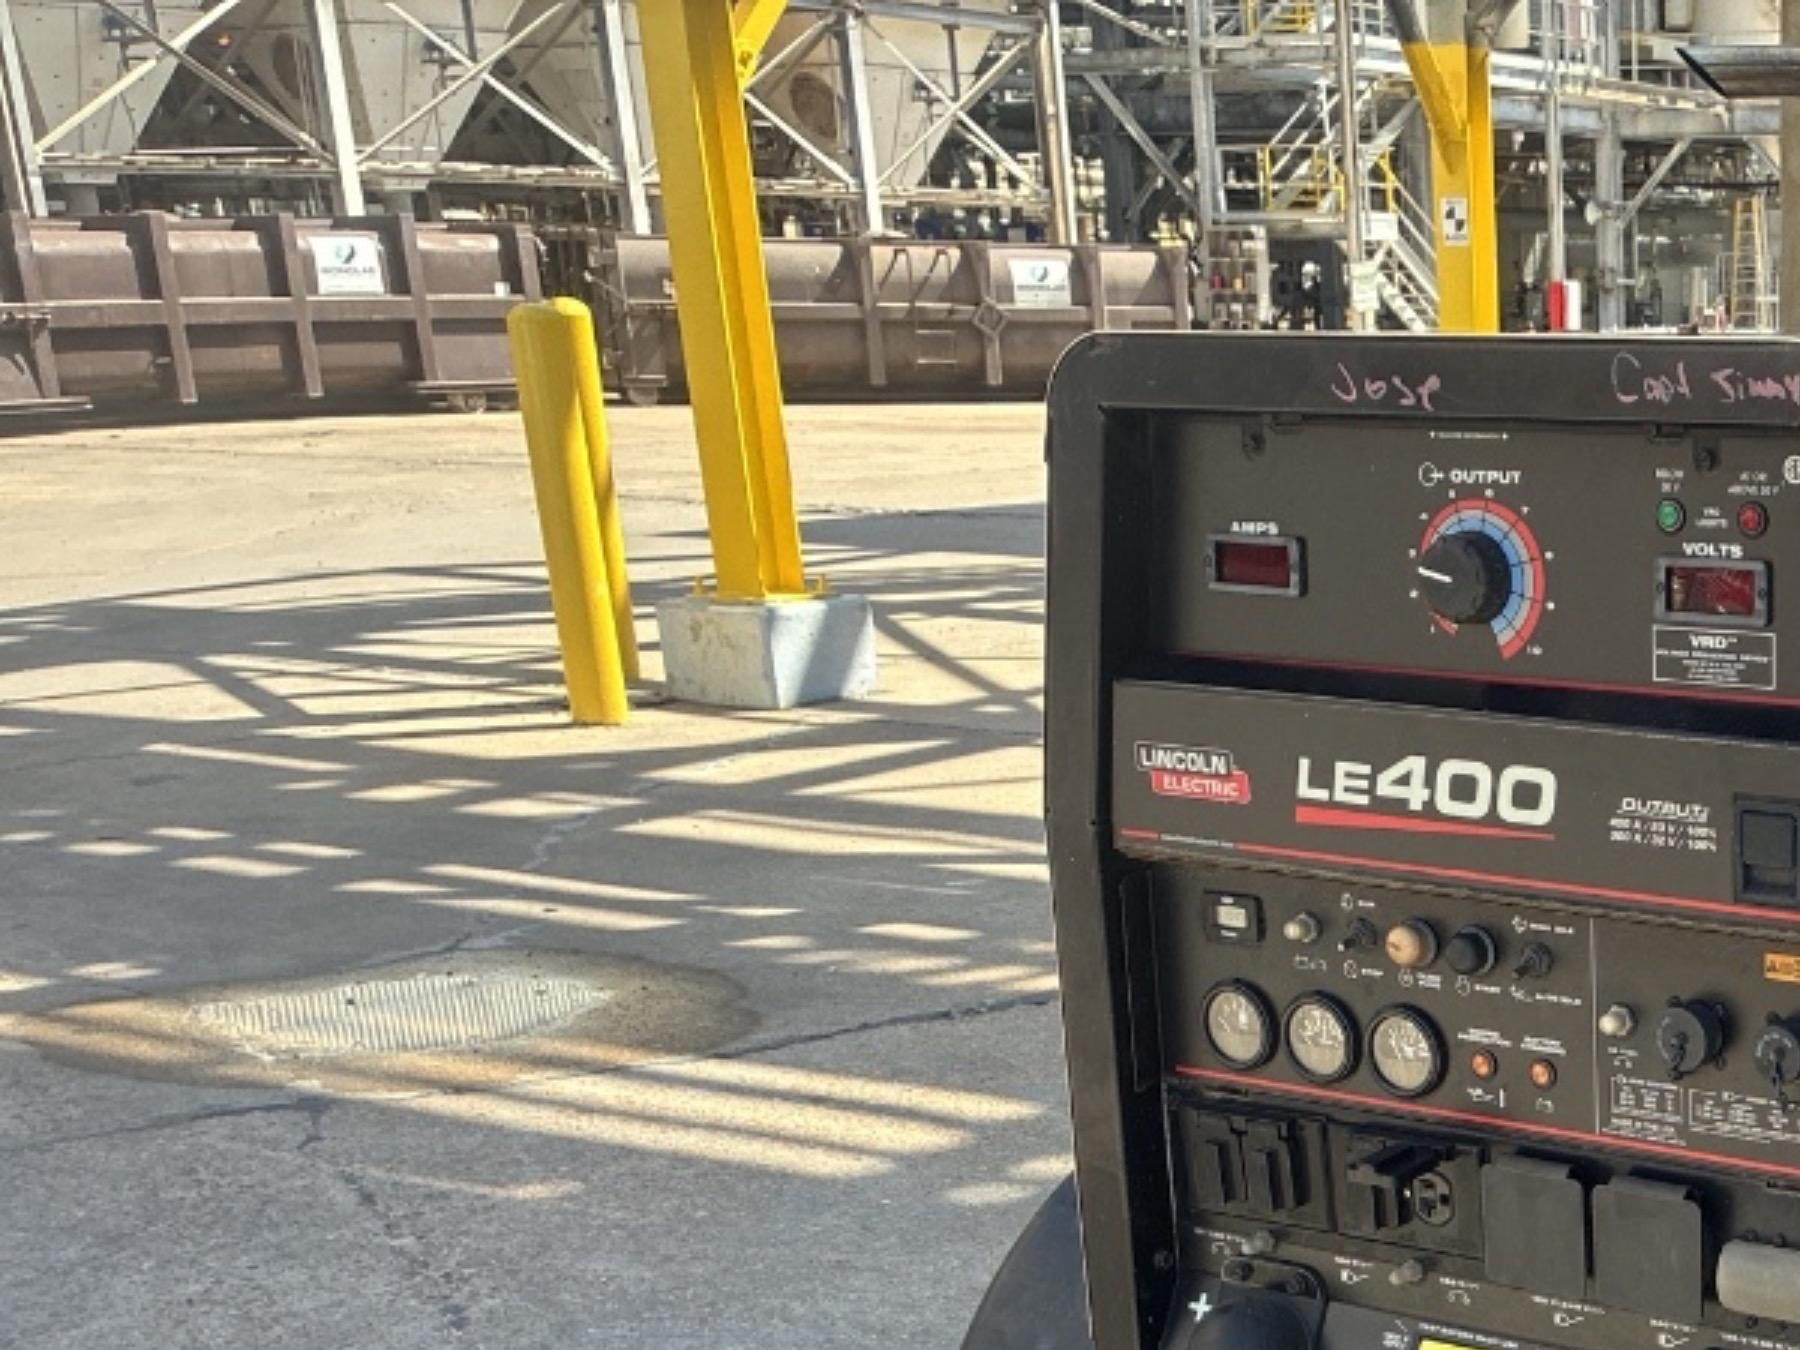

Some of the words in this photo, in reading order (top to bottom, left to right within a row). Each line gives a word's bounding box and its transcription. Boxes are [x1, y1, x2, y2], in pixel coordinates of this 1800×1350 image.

[1450, 470, 1521, 484] OUTPUT
[1230, 521, 1279, 535] AMPS
[1682, 542, 1743, 558] VOLTS
[1139, 746, 1228, 775] LINCOLN
[1162, 775, 1240, 797] ELECTRIC
[1297, 754, 1557, 826] LE400
